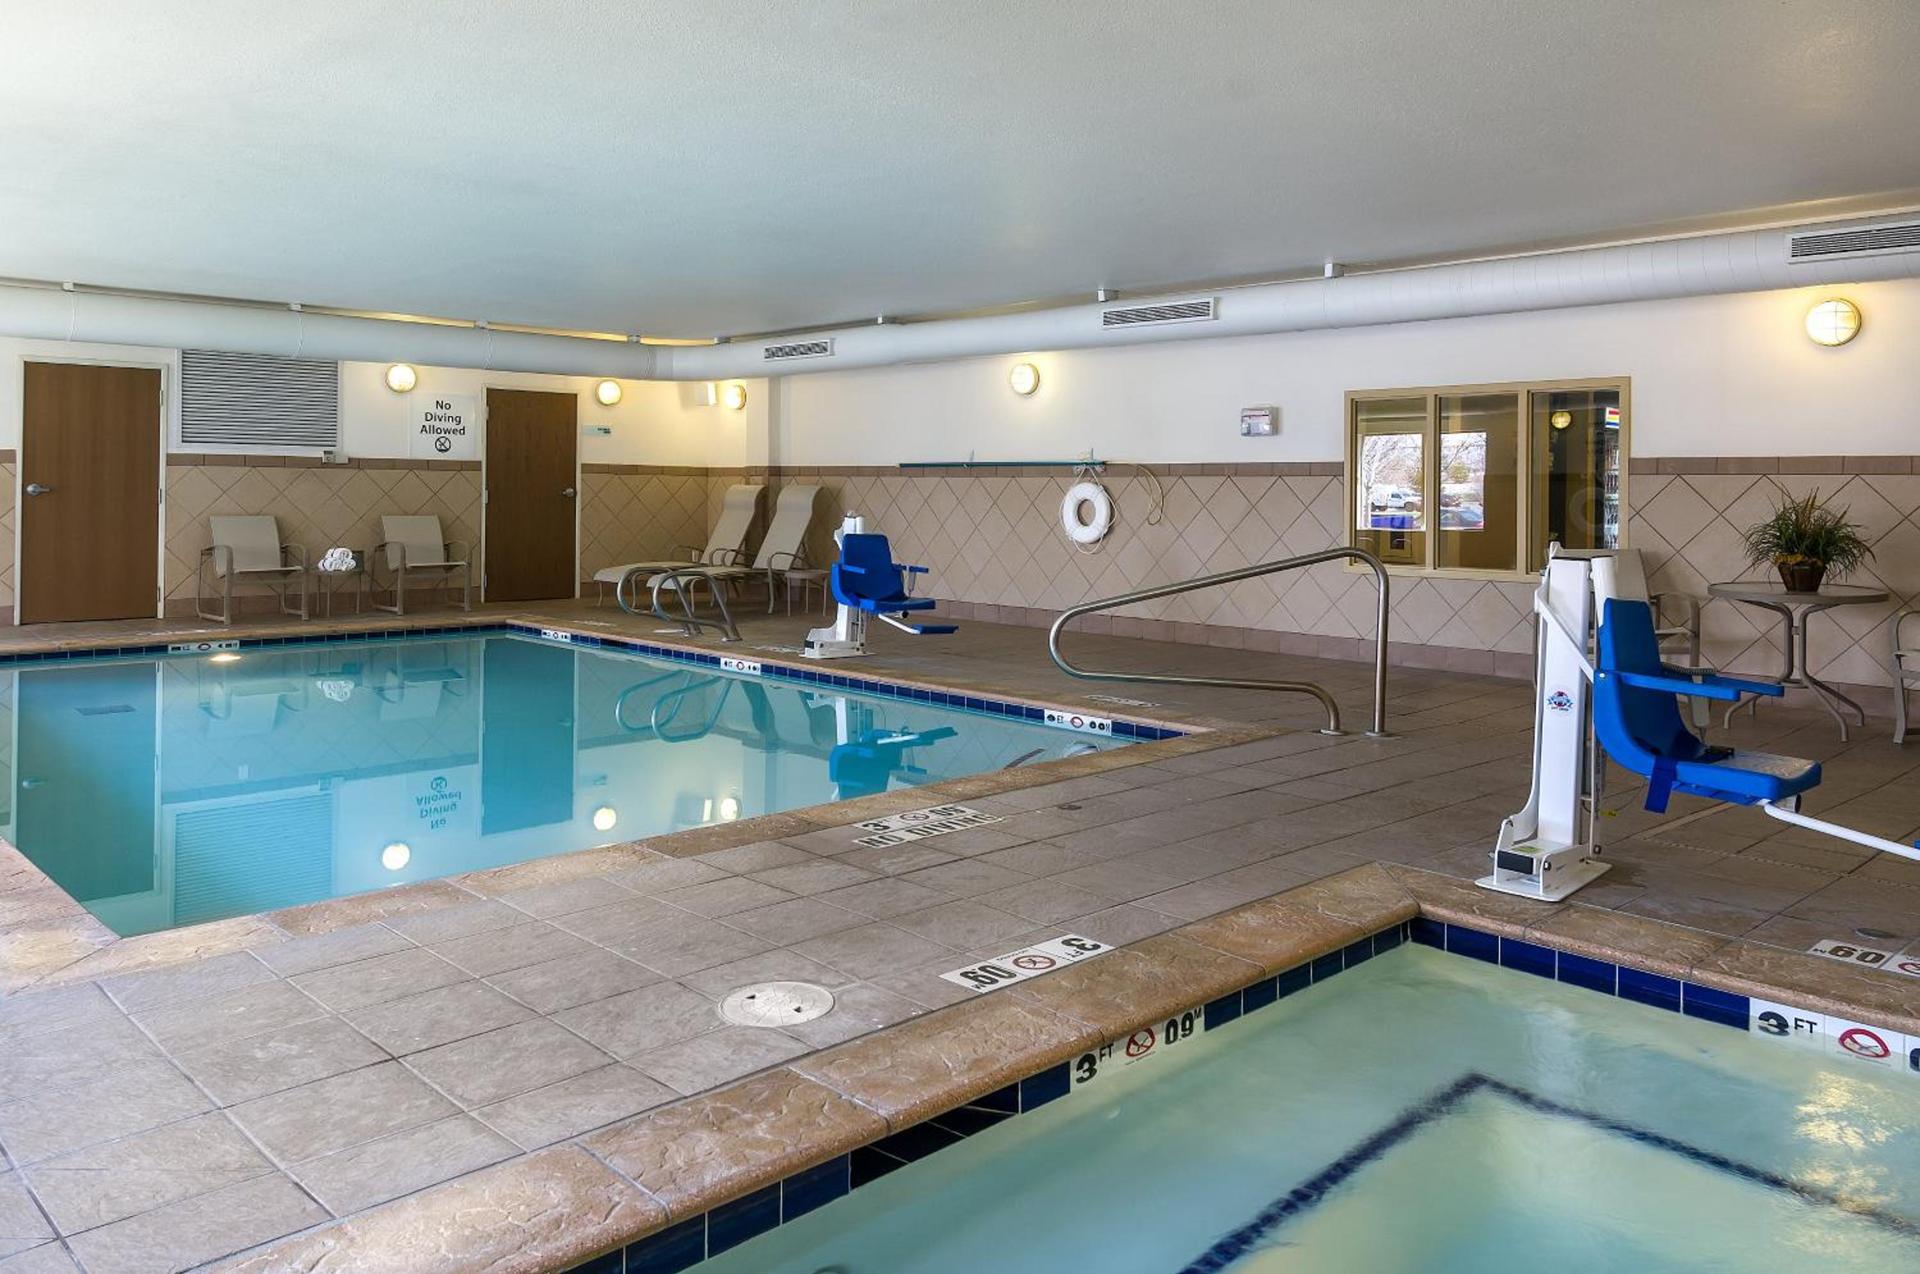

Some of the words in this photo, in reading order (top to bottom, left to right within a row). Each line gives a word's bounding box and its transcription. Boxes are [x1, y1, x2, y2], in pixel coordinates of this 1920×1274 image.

[435, 400, 452, 410] No
[424, 412, 462, 426] Diving
[420, 425, 466, 435] Allowed
[857, 834, 906, 848] NO
[1061, 937, 1102, 952] 3
[1794, 1017, 1818, 1034] FT
[1076, 1053, 1098, 1084] 3
[1100, 1043, 1114, 1062] FT
